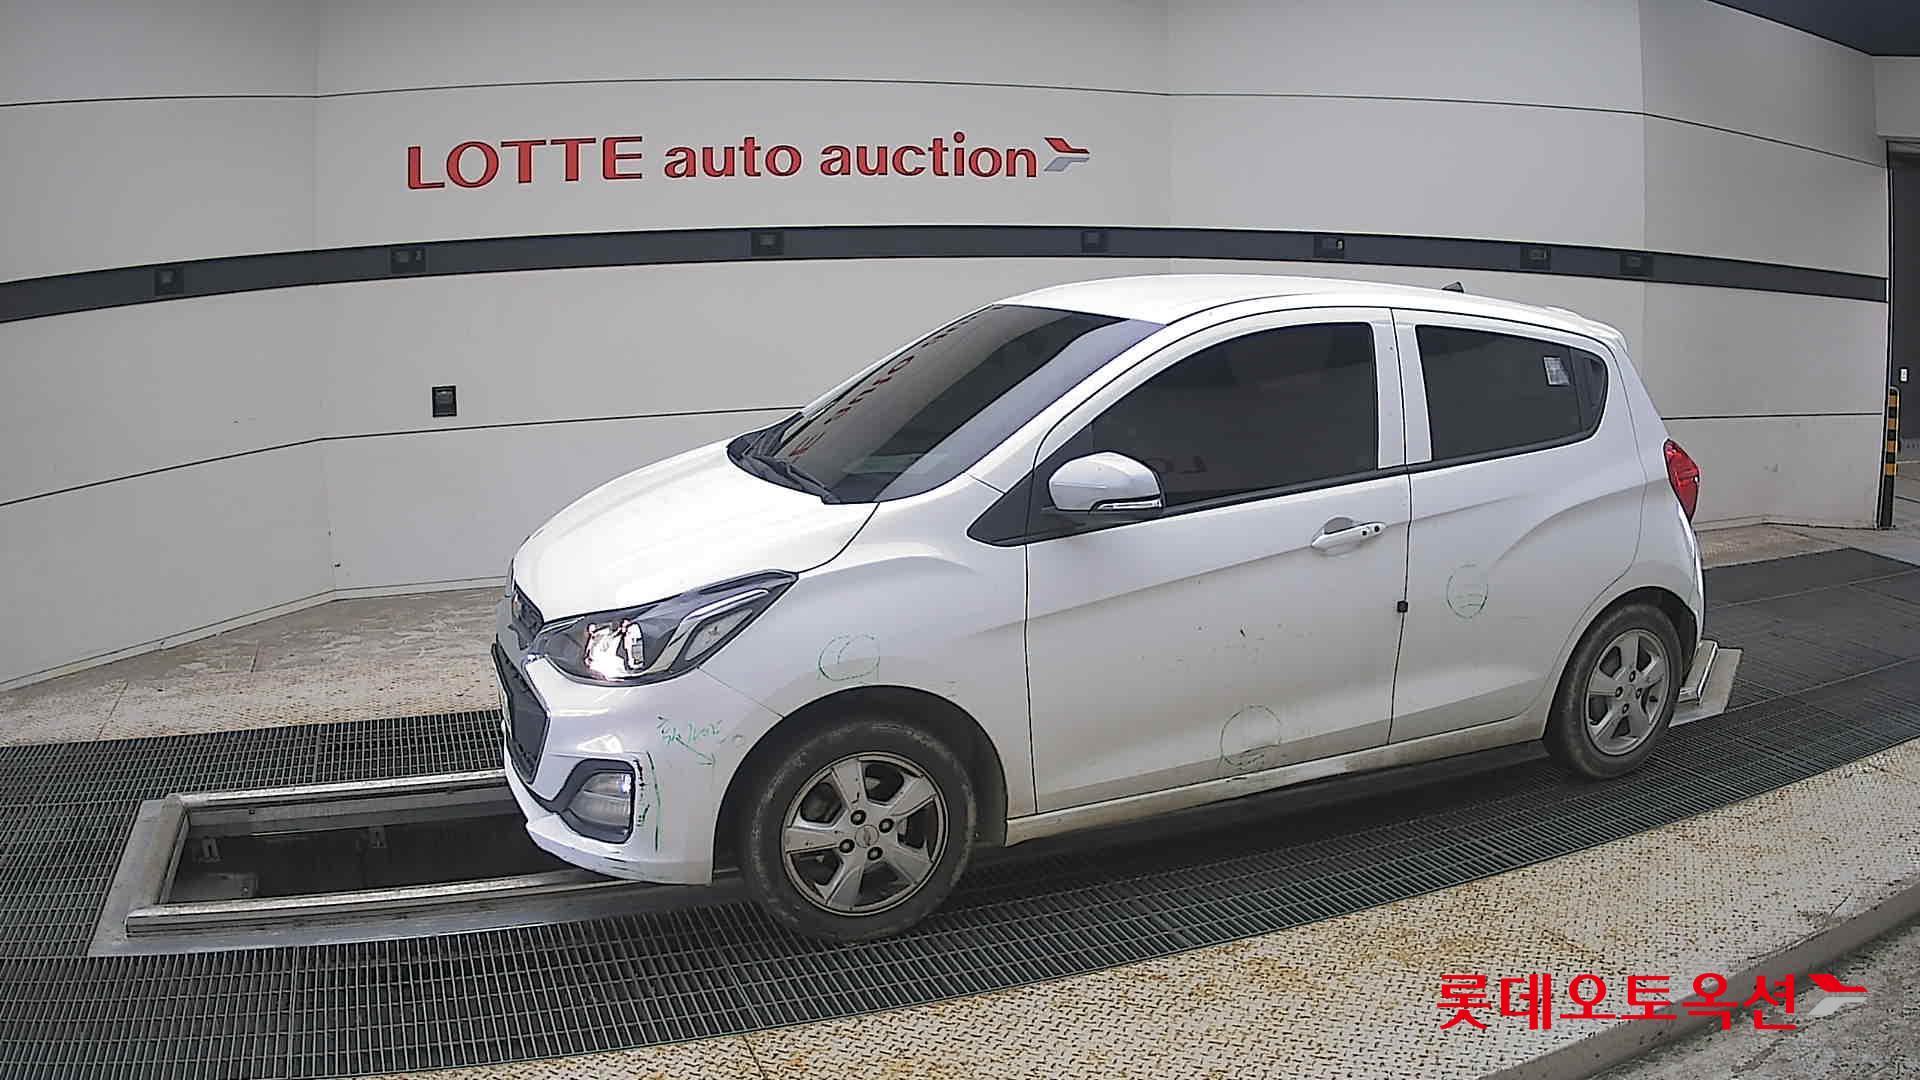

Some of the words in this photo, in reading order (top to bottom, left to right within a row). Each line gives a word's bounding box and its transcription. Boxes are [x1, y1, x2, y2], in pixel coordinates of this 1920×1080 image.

[407, 135, 644, 190] LOTTE
[664, 137, 802, 178] auto
[820, 131, 1038, 178] auction
